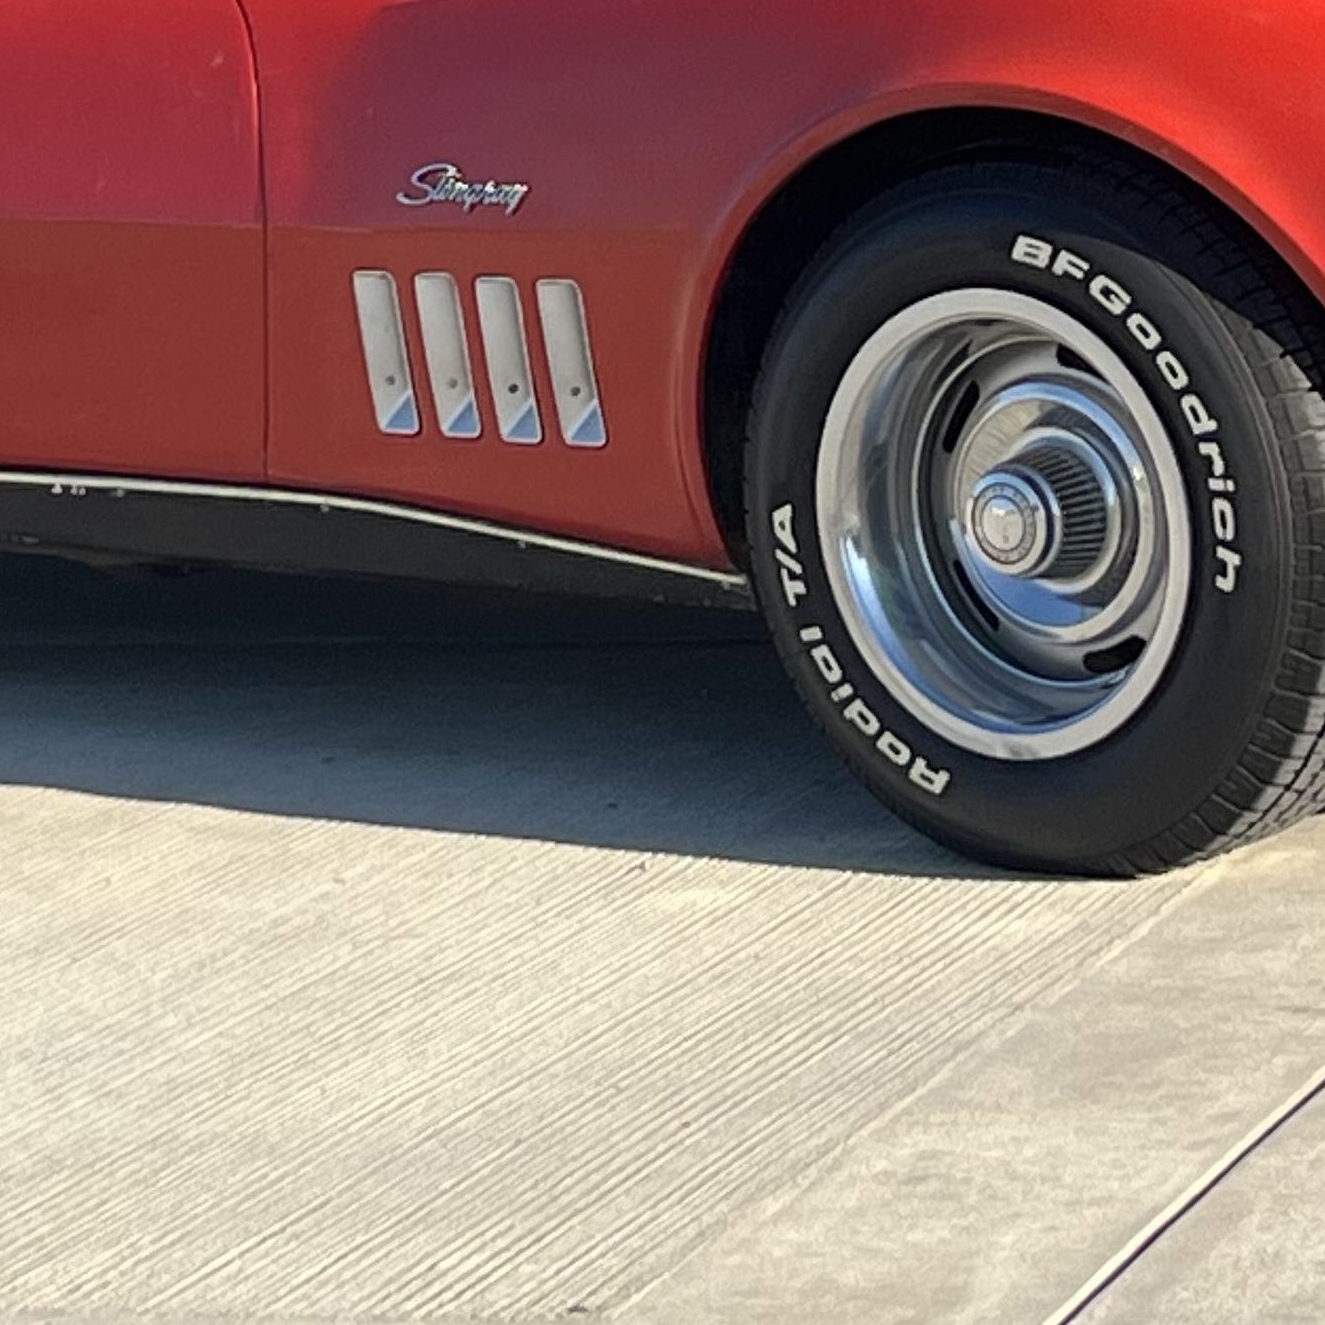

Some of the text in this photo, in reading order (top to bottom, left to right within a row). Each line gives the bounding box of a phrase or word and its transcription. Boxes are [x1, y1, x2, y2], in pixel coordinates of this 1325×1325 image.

[395, 162, 529, 216] Stingray
[1010, 234, 1242, 593] BFGoodrich
[771, 503, 951, 796] Radial T/A
